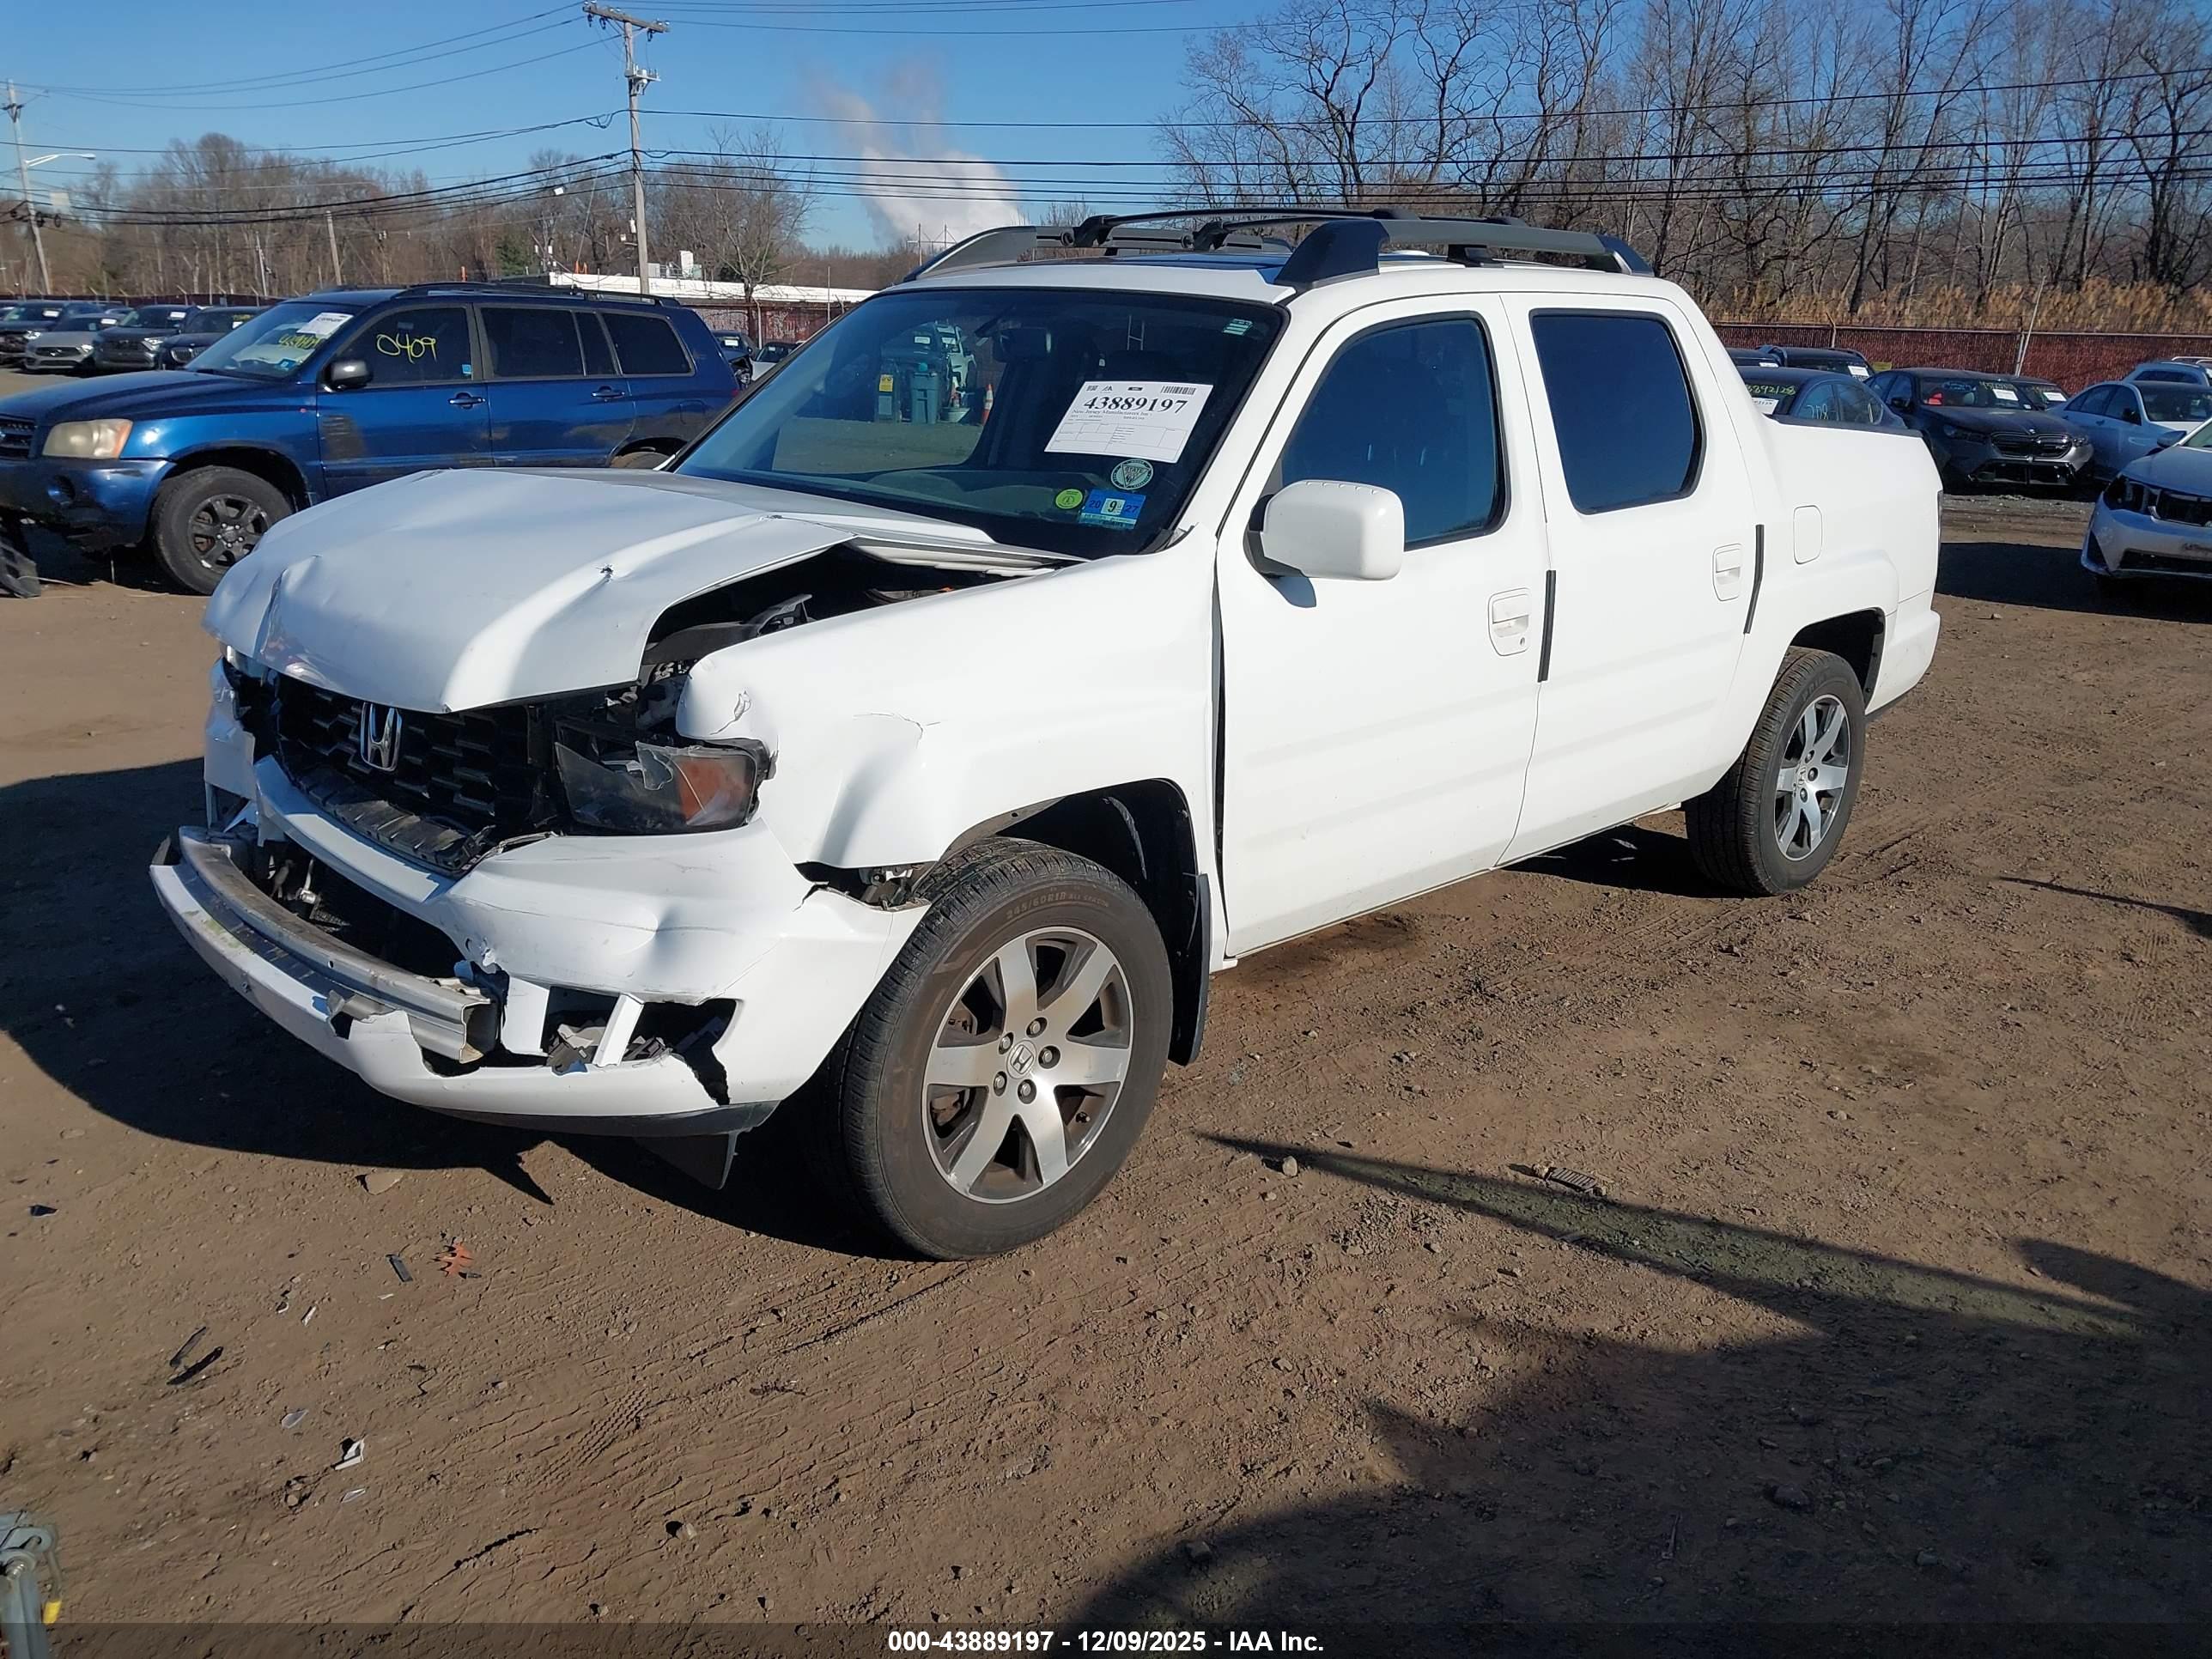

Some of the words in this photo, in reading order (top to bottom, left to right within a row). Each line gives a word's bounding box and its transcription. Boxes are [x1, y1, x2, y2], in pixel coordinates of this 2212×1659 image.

[376, 333, 437, 364] 0409
[1084, 396, 1188, 413] 43889197
[1108, 501, 1117, 513] 9
